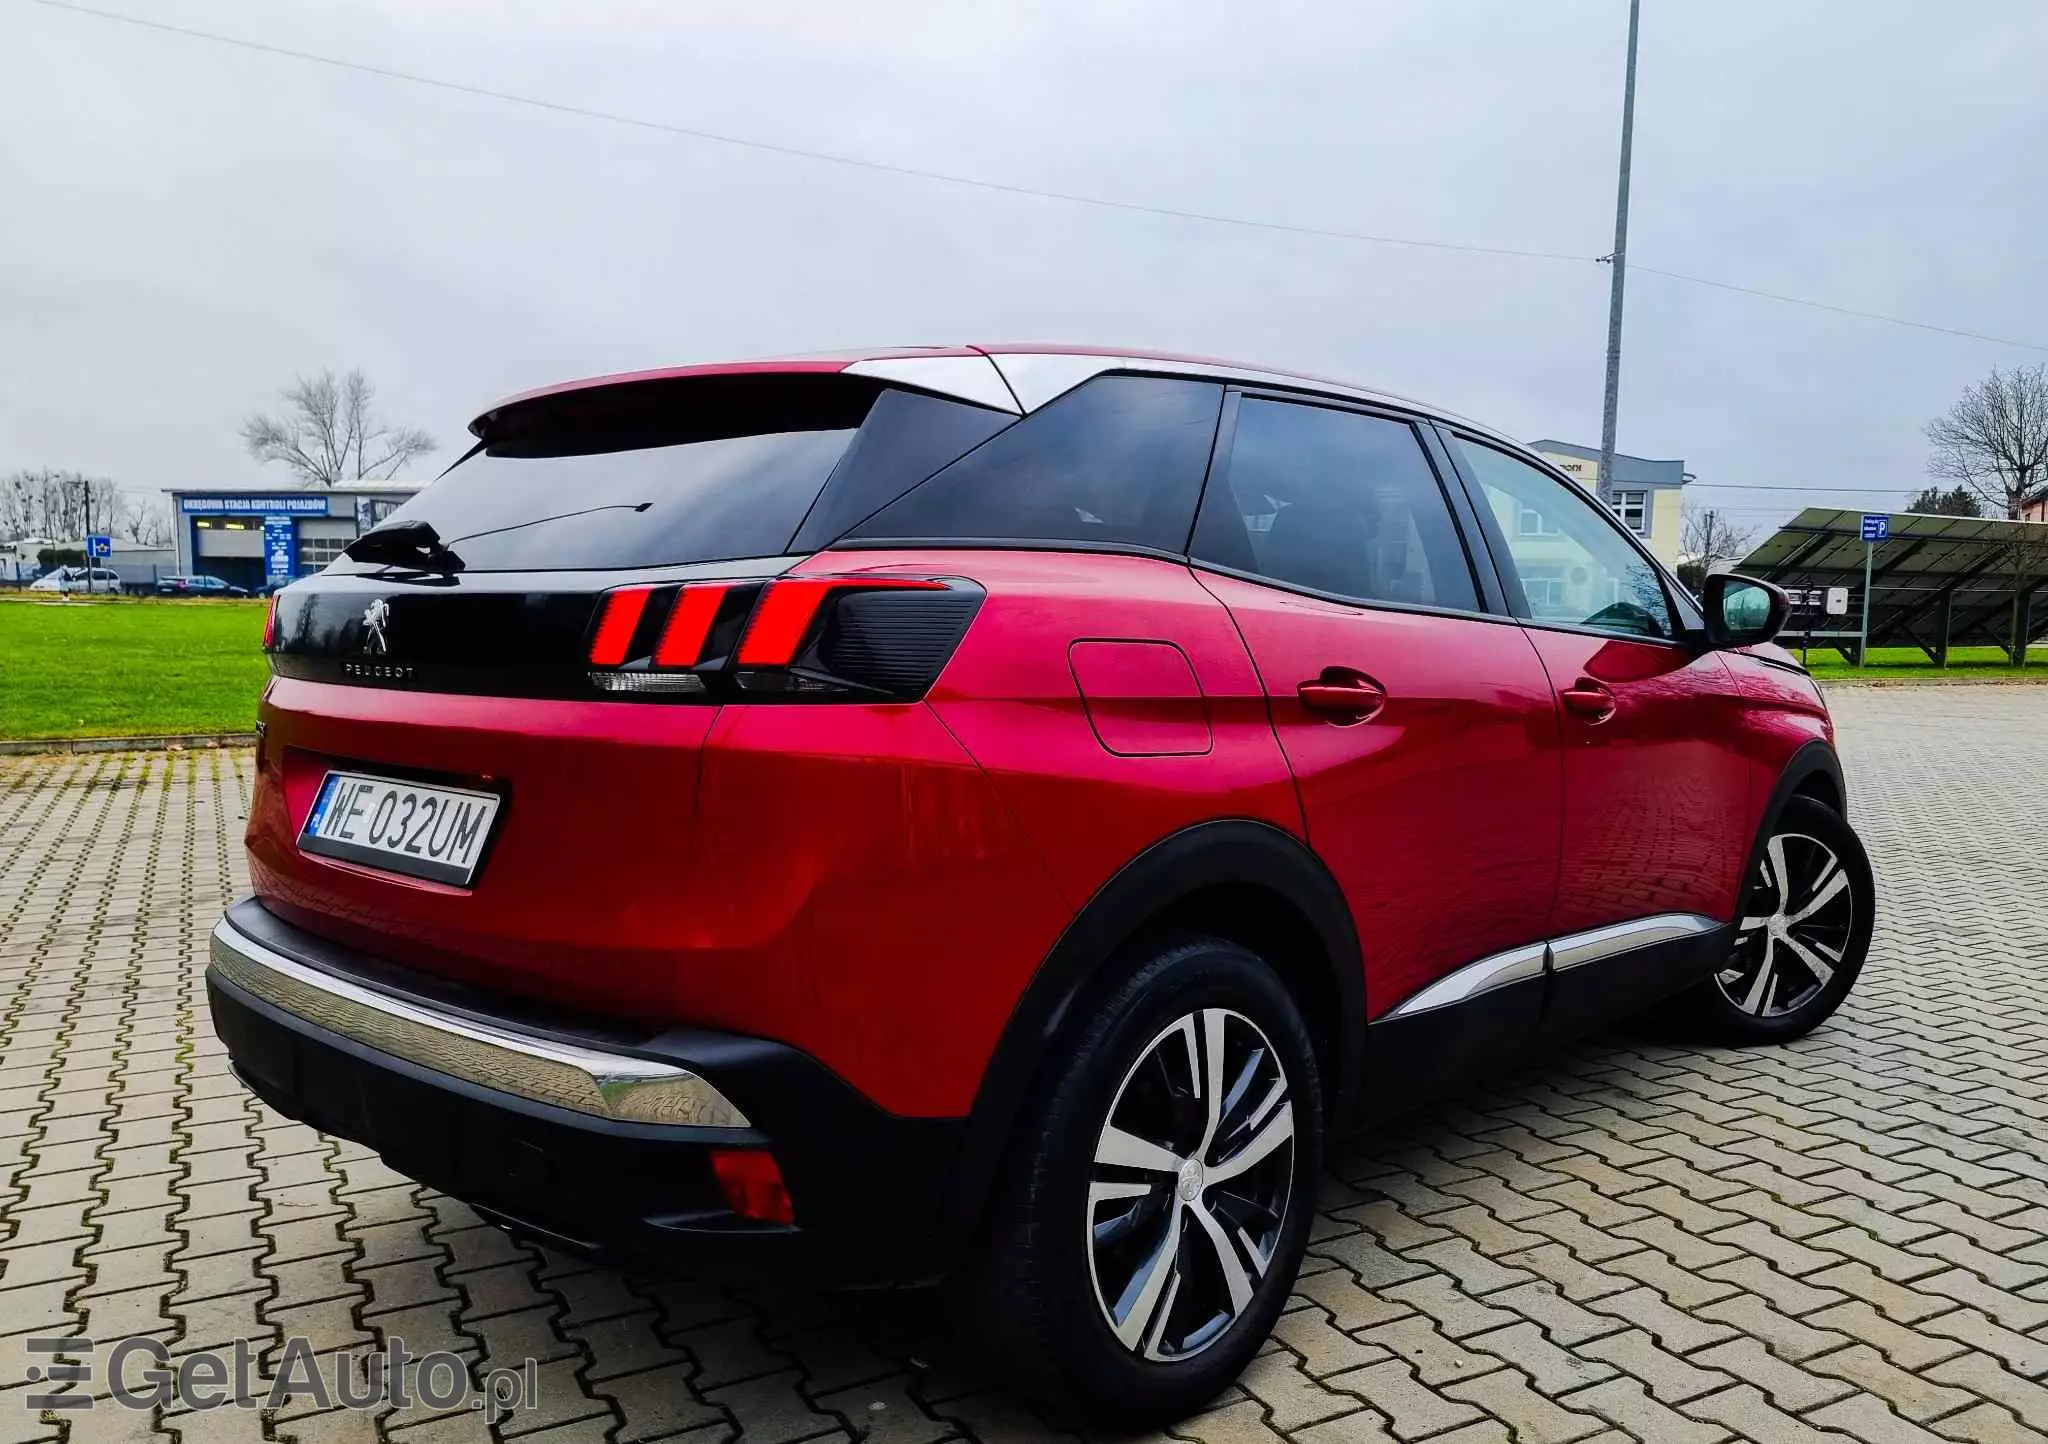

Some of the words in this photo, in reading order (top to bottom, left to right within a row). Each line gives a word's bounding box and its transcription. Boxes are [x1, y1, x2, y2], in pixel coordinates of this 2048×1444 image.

[344, 663, 414, 678] PEUGEOT
[323, 782, 374, 840] WE
[368, 790, 487, 864] 032UM
